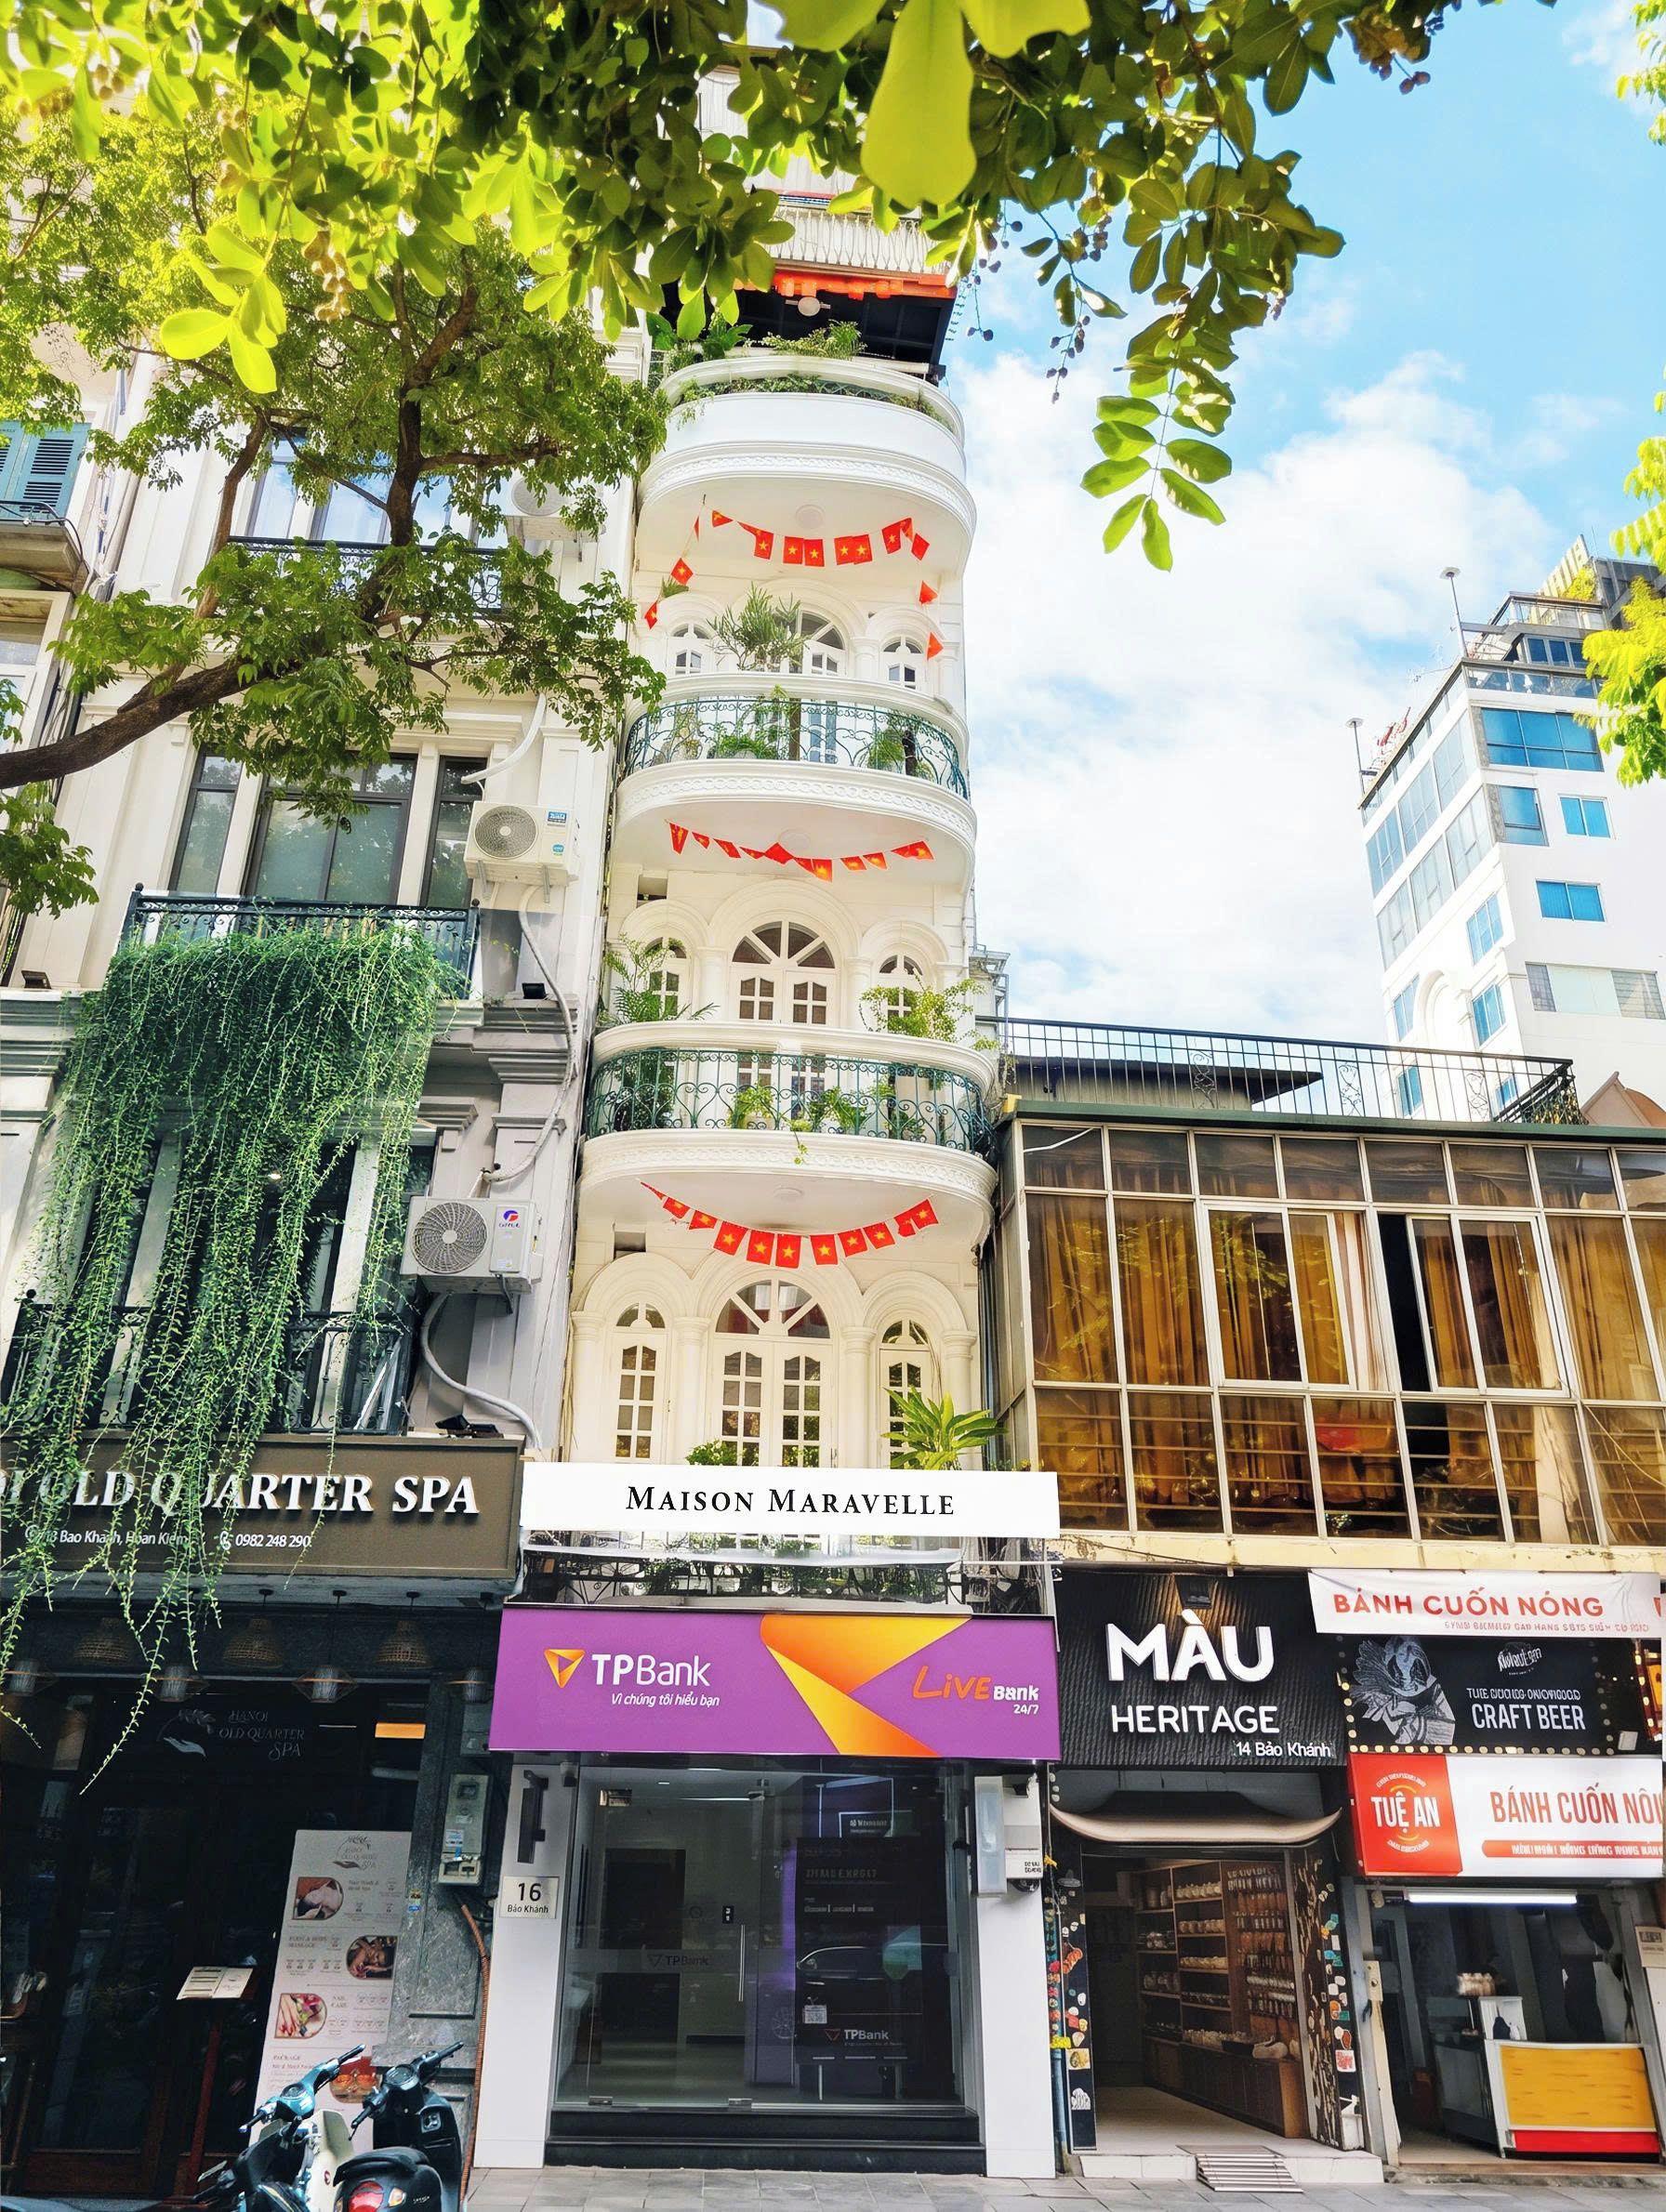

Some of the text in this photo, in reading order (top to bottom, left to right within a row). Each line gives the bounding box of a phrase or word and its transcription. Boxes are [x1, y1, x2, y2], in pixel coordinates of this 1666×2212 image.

[38, 1469, 135, 1507] OLD
[392, 1475, 481, 1514] SPA
[626, 1486, 954, 1516] MAISON MARAVELLE
[60, 1530, 82, 1543] Bao
[235, 1534, 311, 1548] 0982 248 290
[1423, 1587, 1509, 1616] CUỐN
[1518, 1590, 1603, 1617] NÓNG
[1105, 1609, 1275, 1682] MÀU
[591, 1654, 711, 1686] TPBank
[624, 1693, 656, 1707] chúng
[659, 1693, 673, 1705] tôi
[675, 1691, 698, 1706] hiểu
[700, 1693, 721, 1707] bạn
[993, 1685, 1038, 1701] Bank
[1013, 1704, 1038, 1715] 24/7
[1111, 1705, 1280, 1733] HERITAGE
[1472, 1704, 1586, 1731] CRAFT BEER
[1236, 1741, 1331, 1757] 14 Bảo Khánh
[1370, 1791, 1441, 1834] TUỆ AN
[1490, 1785, 1553, 1824] BÁNH
[1556, 1782, 1619, 1824] CUỐN
[519, 1882, 541, 1902] 16
[844, 2029, 889, 2040] TPBank
